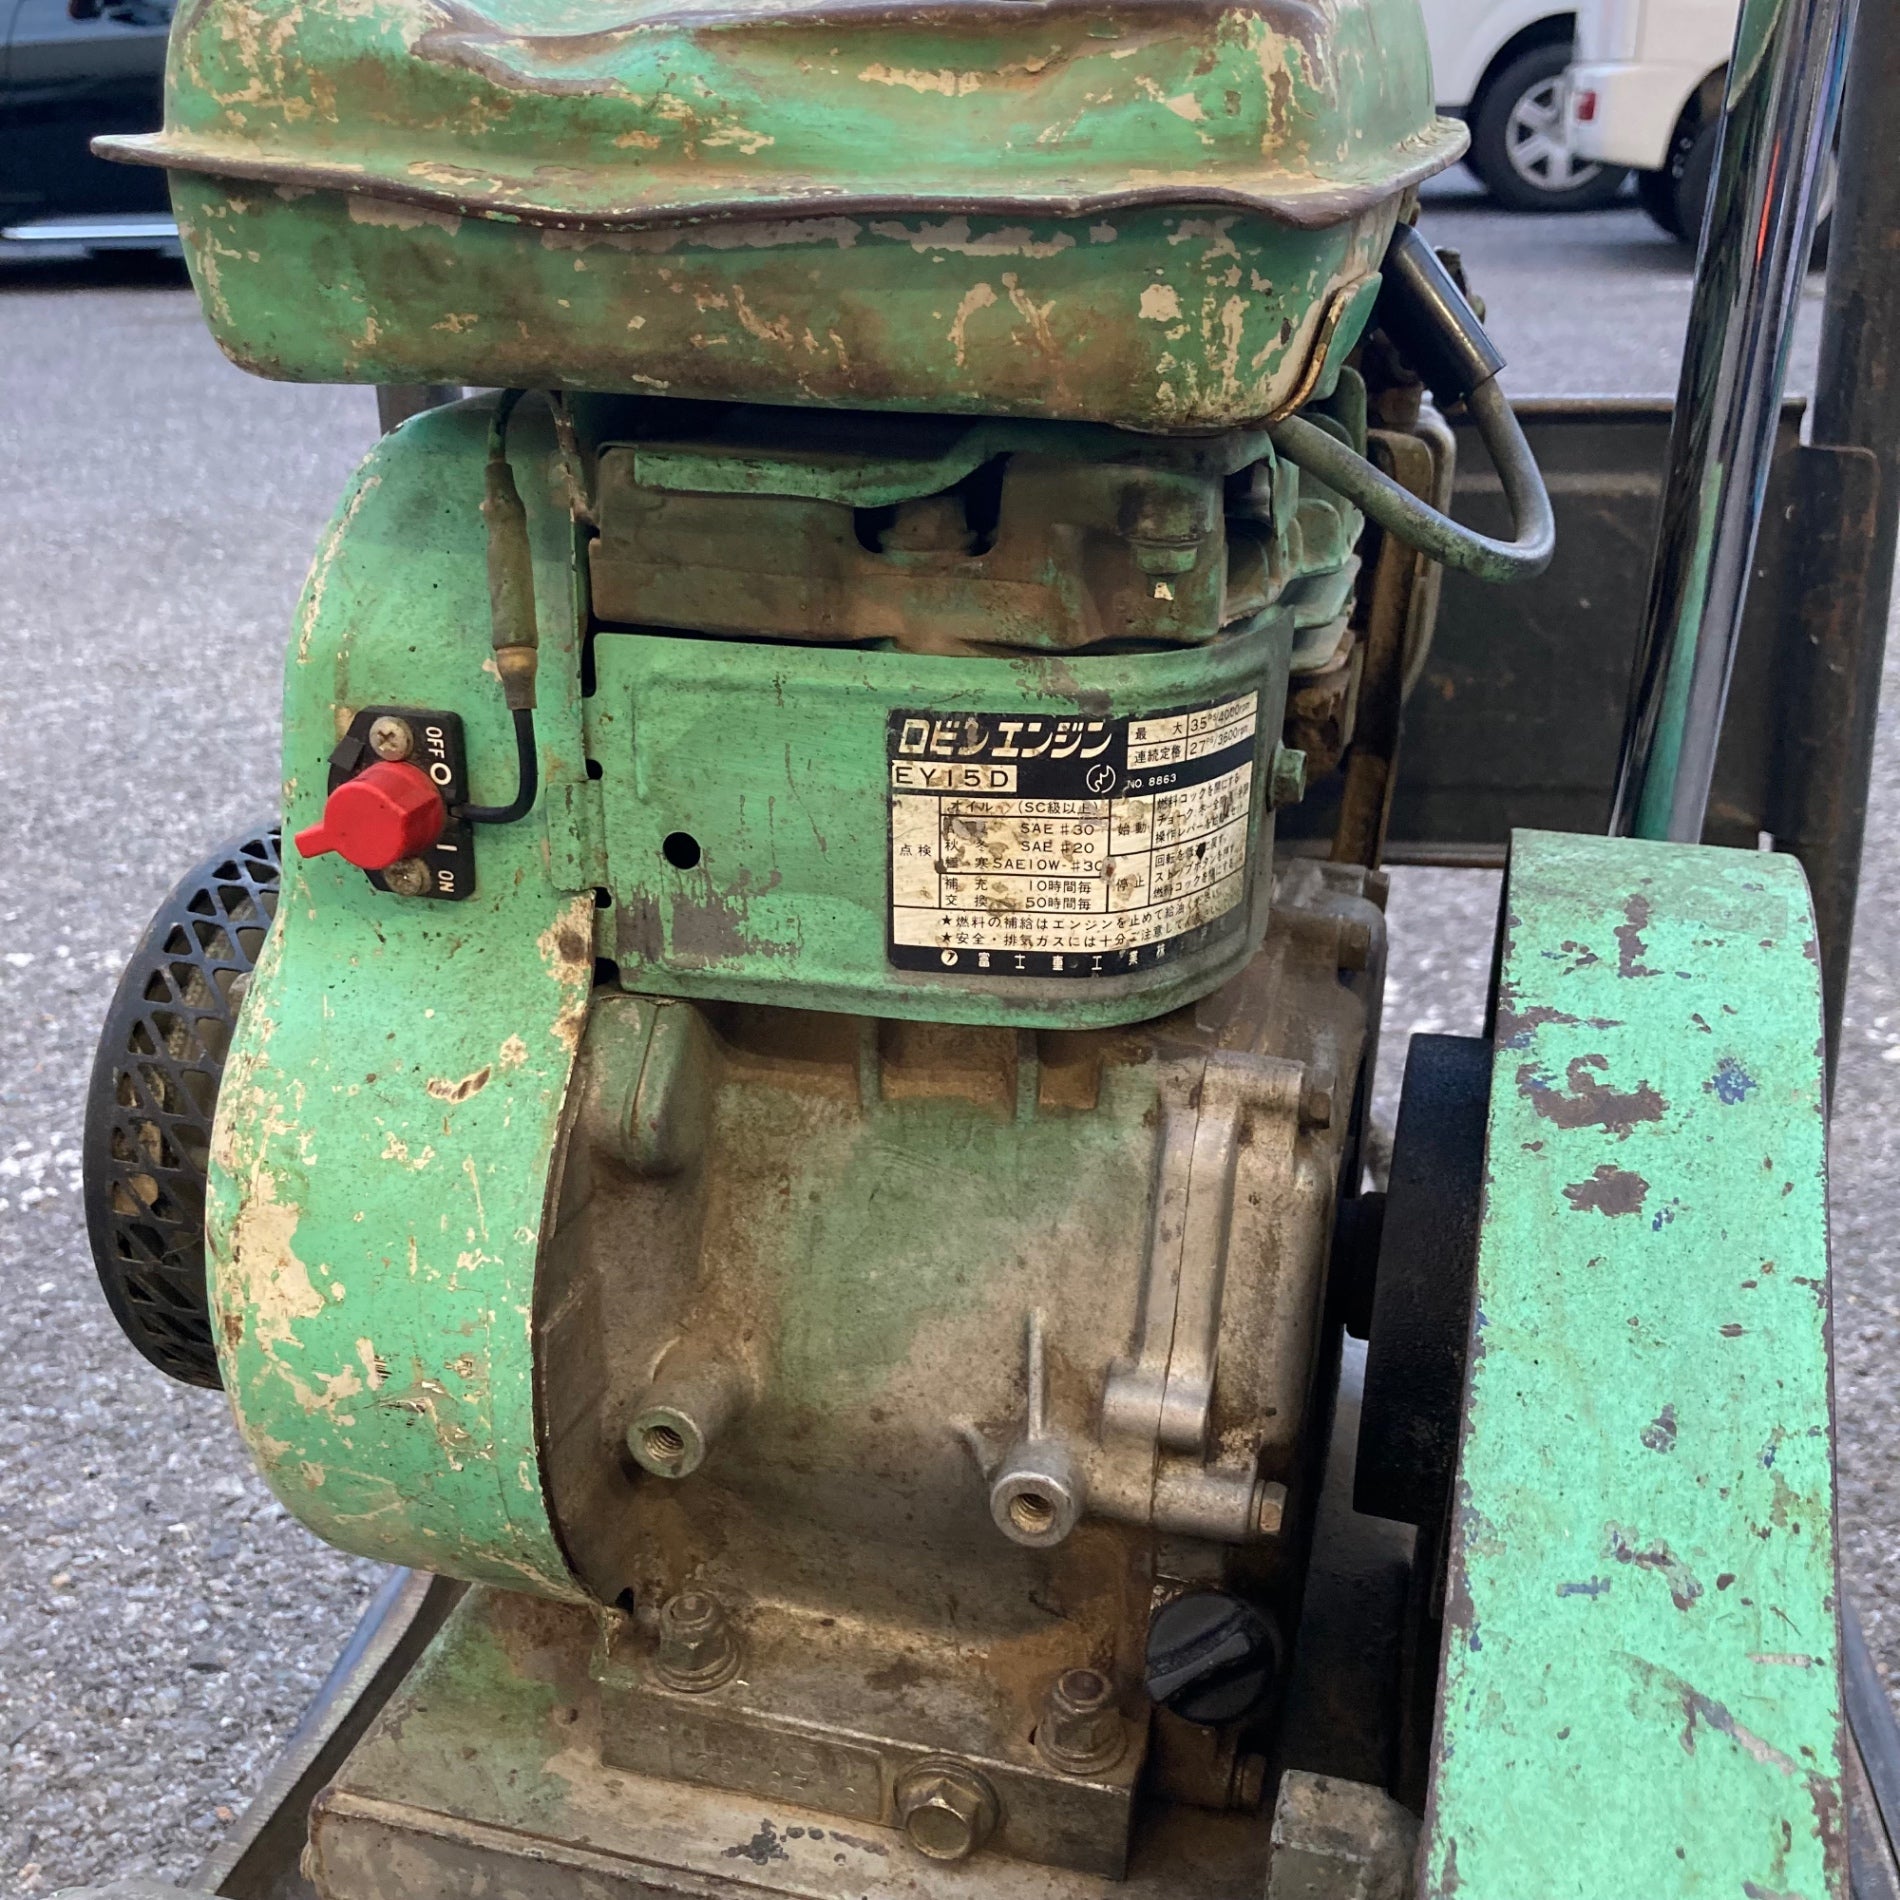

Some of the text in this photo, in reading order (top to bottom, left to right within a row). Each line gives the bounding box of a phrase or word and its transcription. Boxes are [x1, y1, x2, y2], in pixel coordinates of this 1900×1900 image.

[425, 726, 445, 759] OFF
[1135, 745, 1181, 764] 連続定格
[896, 766, 1009, 788] EY15D
[1148, 773, 1177, 787] 8863
[1021, 823, 1054, 836] SAE
[1118, 822, 1147, 837] 始動
[899, 843, 932, 857] 点検
[1021, 840, 1052, 853] SAE
[438, 870, 455, 893] ON
[1029, 879, 1092, 894] 10時間毎
[1116, 875, 1145, 892] 停止
[1026, 896, 1092, 911] 50時間毎
